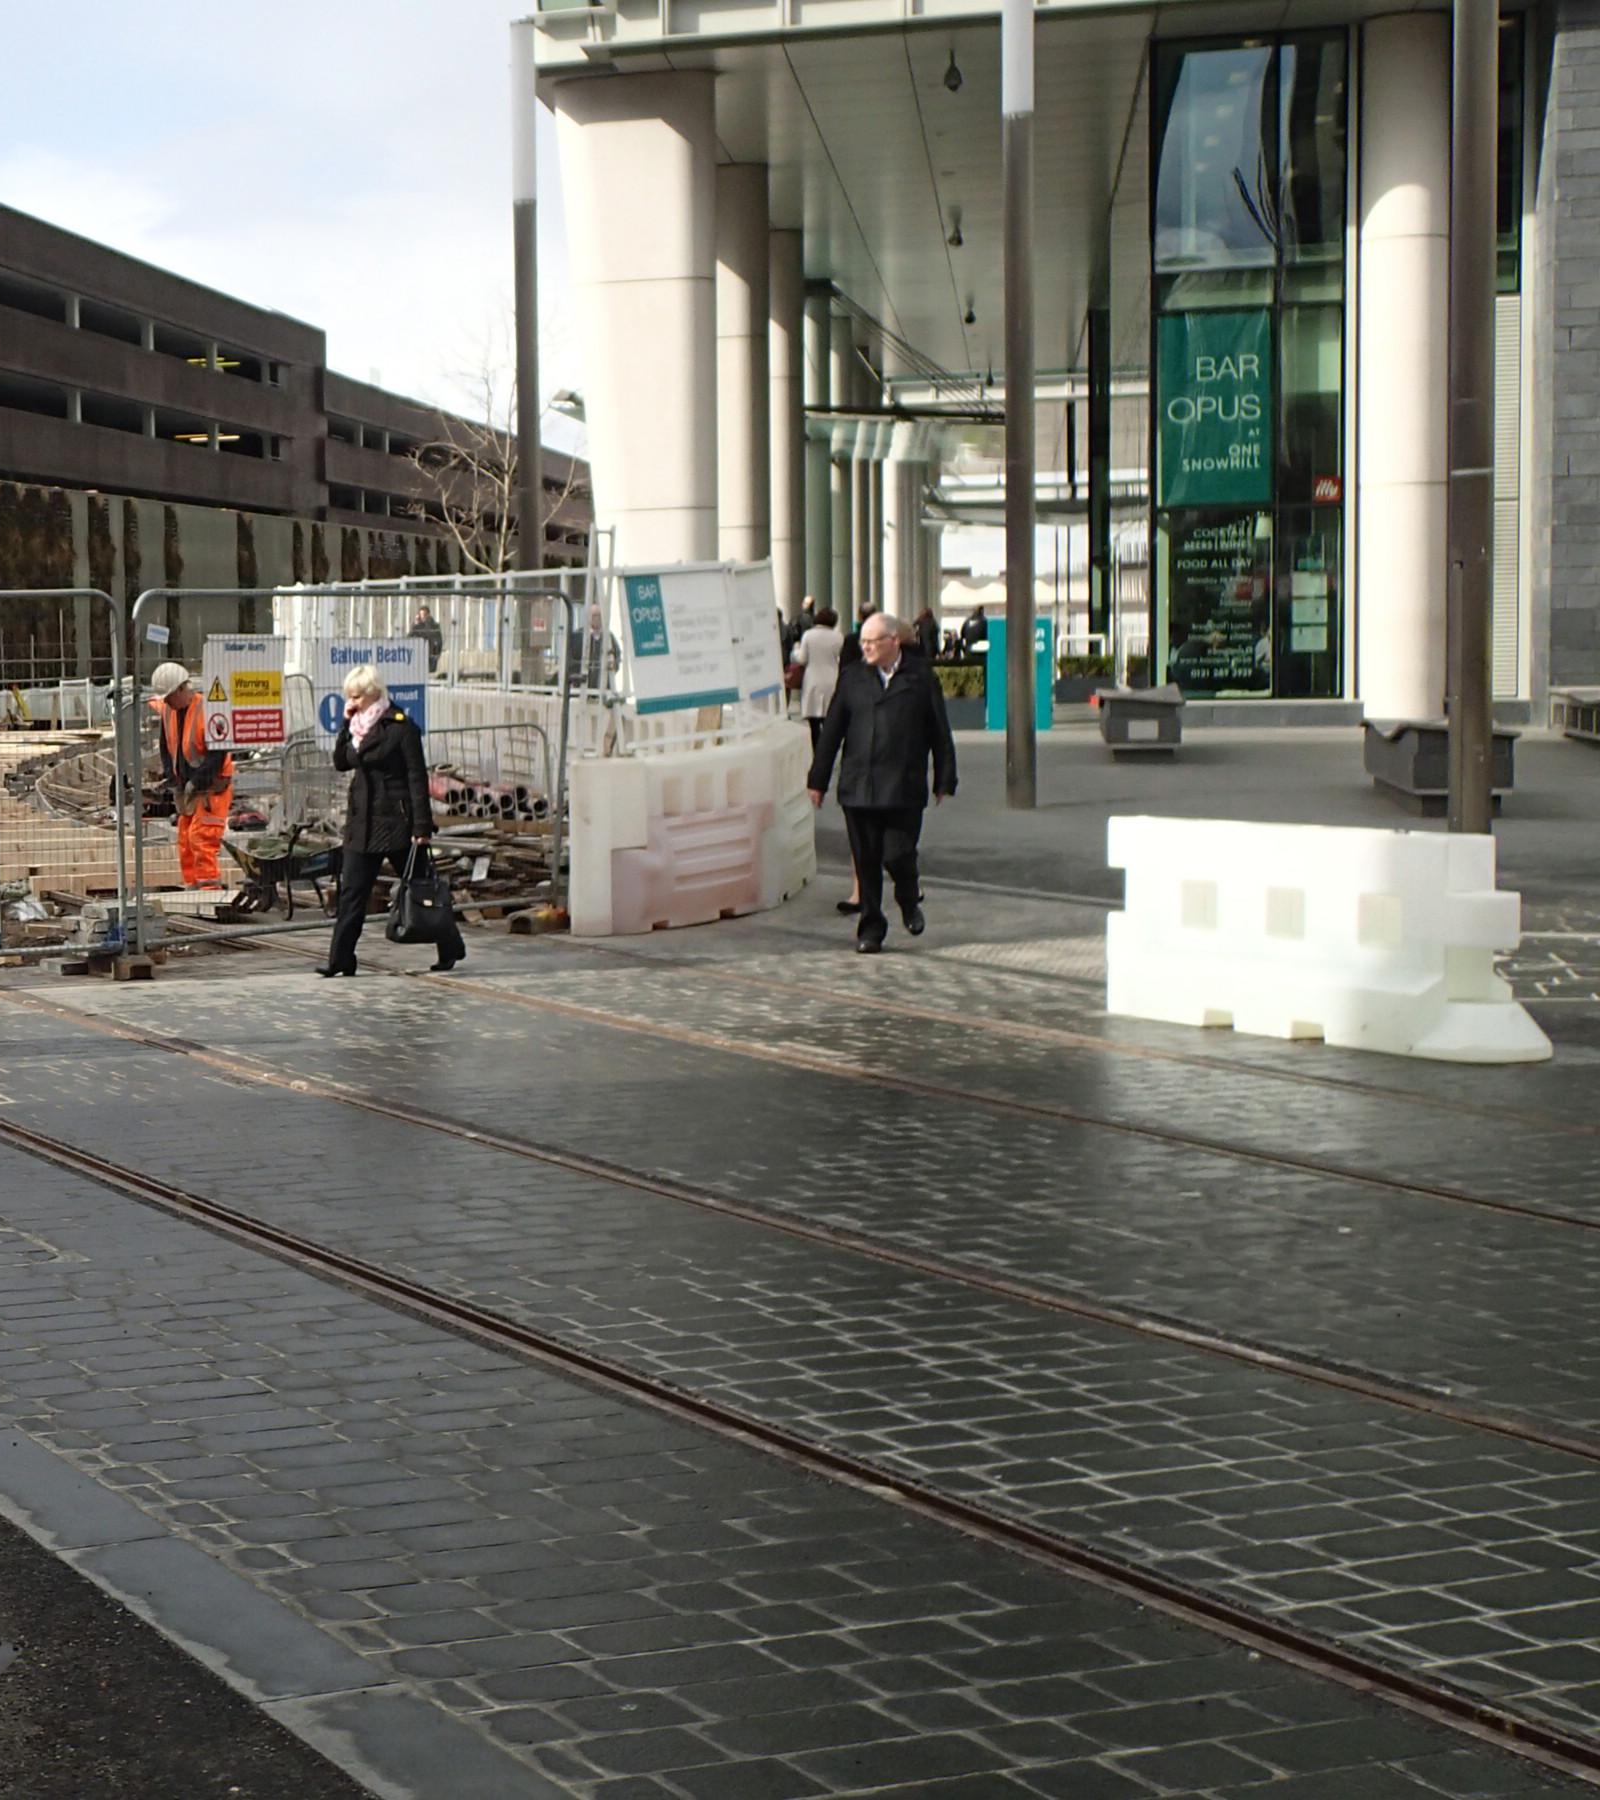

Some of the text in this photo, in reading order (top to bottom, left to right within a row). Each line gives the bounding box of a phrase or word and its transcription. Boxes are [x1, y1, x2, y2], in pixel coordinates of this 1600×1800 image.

[1196, 354, 1259, 381] BAR
[1167, 394, 1261, 423] OPUS
[1248, 427, 1260, 437] AT
[1229, 443, 1260, 457] ONE
[1182, 455, 1260, 472] SNOWHILL
[1315, 479, 1339, 499] illy
[1177, 558, 1252, 569] FOOD ALL DAY
[638, 584, 659, 600] BAR
[633, 606, 662, 623] OPUS
[331, 645, 413, 664] Balfour Beatty
[235, 679, 269, 690] Warning
[396, 690, 419, 700] must
